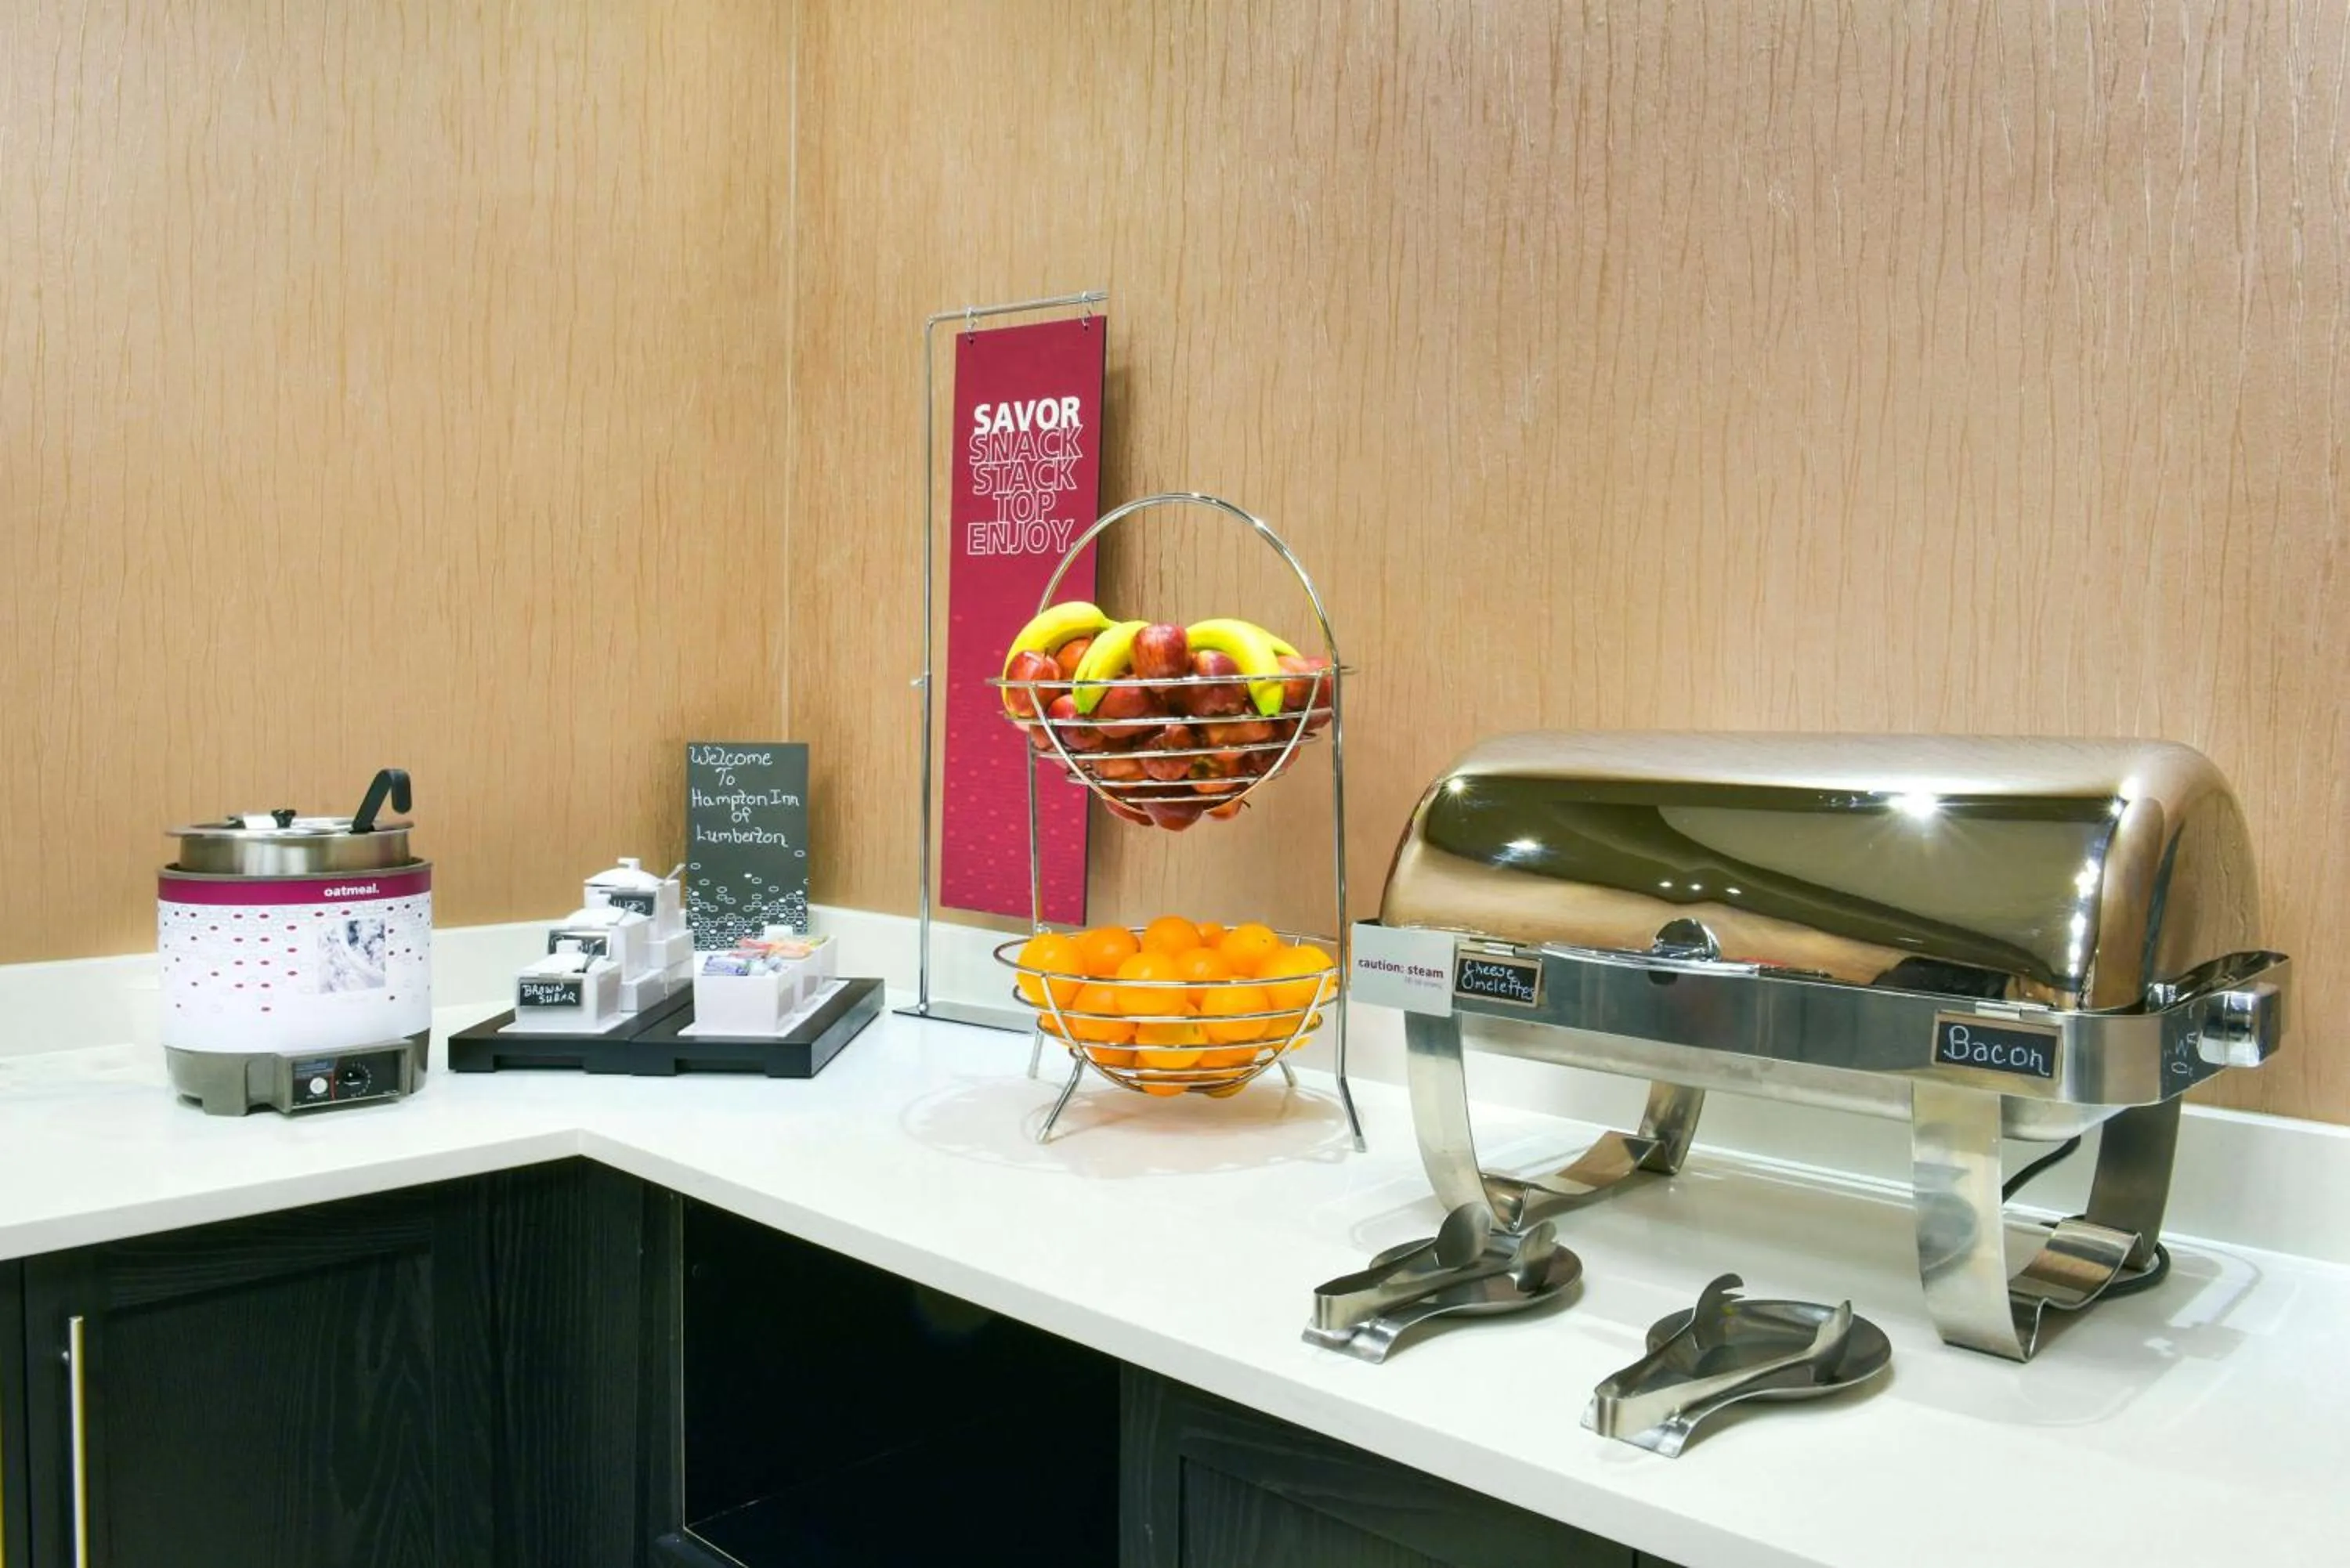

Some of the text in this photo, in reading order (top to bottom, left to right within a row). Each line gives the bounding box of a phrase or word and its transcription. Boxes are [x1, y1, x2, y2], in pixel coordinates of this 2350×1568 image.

[974, 396, 1081, 436] SAVOR
[969, 424, 1083, 464] SNACK
[972, 456, 1077, 495] STACK
[992, 489, 1056, 523] TOP
[689, 746, 773, 766] Welcome
[715, 767, 736, 786] To
[692, 786, 800, 811] Hampton Inn
[731, 807, 752, 823] of
[696, 823, 789, 847] Lumberton
[324, 883, 380, 897] oatmeal.
[1358, 958, 1444, 978] caution: steam
[1463, 960, 1516, 981] Cheese
[1943, 1025, 2051, 1077] Bacon
